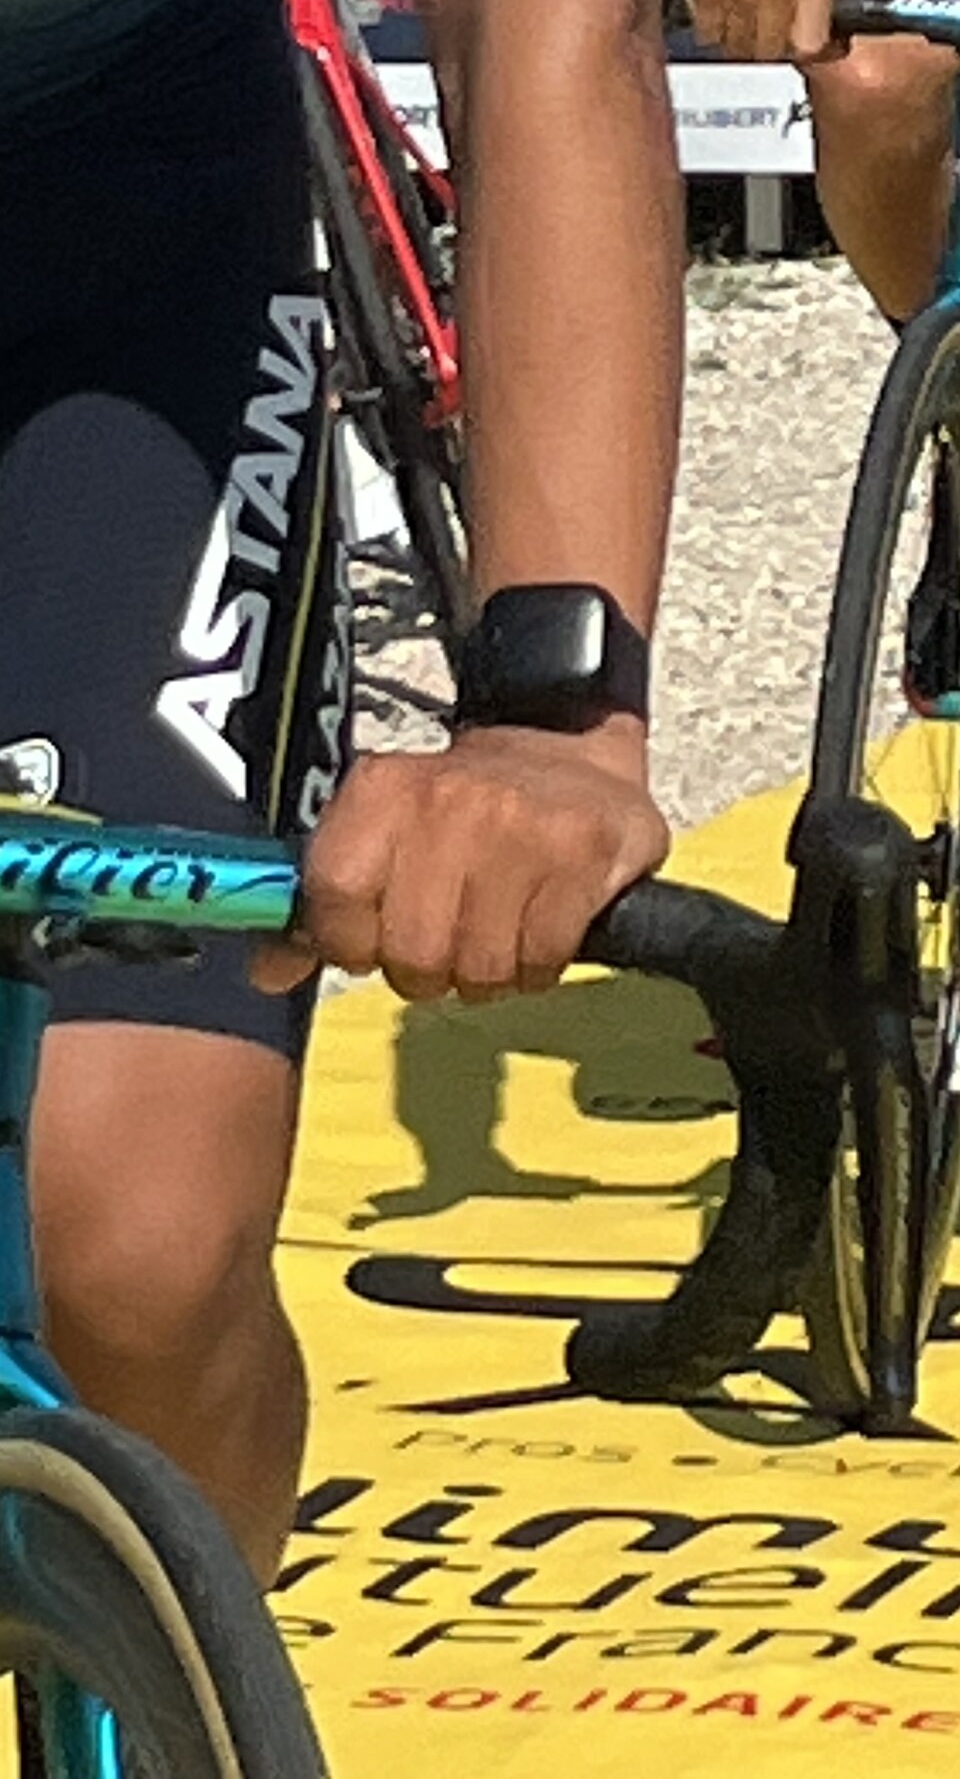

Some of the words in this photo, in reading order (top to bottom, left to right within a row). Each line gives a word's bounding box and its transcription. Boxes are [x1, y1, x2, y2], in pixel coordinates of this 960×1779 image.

[155, 294, 334, 799] ASTANA
[393, 1429, 638, 1464] Pros
[294, 1477, 960, 1558] lim
[270, 1554, 960, 1615] tuel
